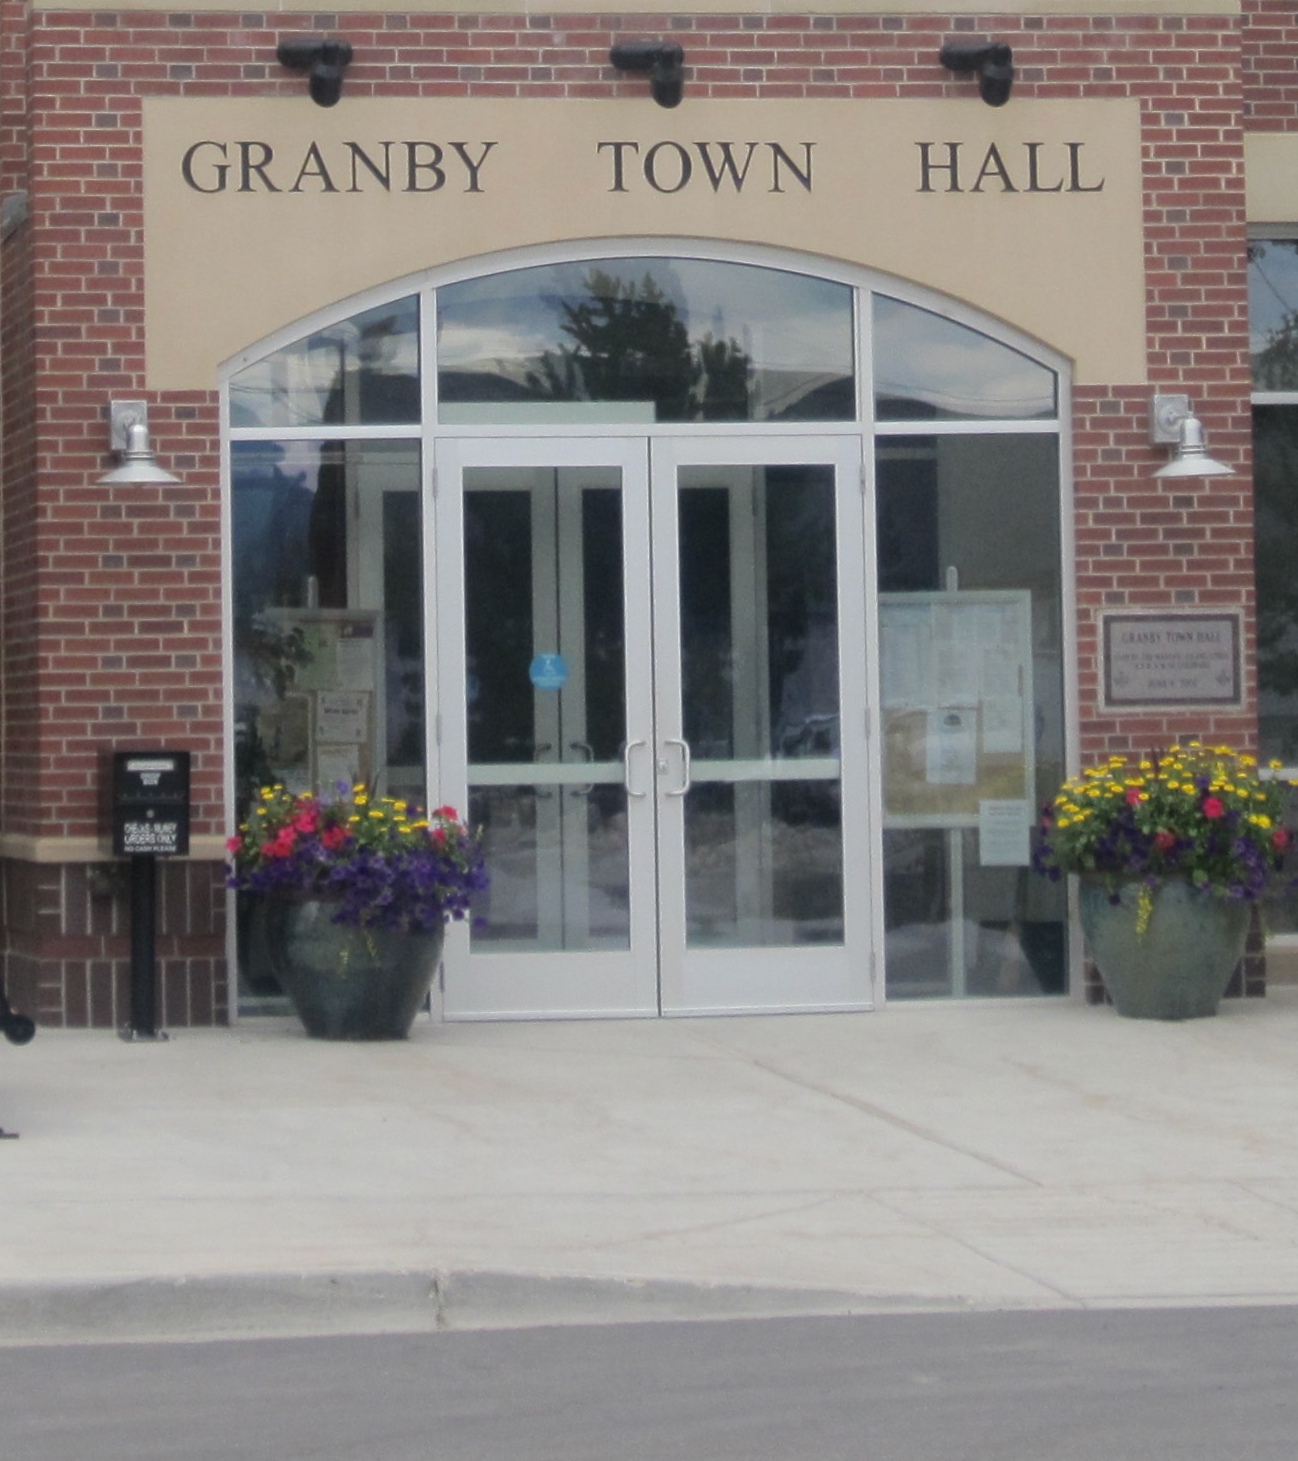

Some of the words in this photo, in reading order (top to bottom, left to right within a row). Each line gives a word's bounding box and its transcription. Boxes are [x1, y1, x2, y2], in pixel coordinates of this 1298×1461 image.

[181, 139, 499, 193] GRANBY
[597, 141, 818, 194] TOWN
[914, 141, 1105, 193] HALL
[1121, 631, 1161, 644] GRANBY
[1165, 631, 1194, 643] TOWN
[1196, 631, 1220, 643] HALL
